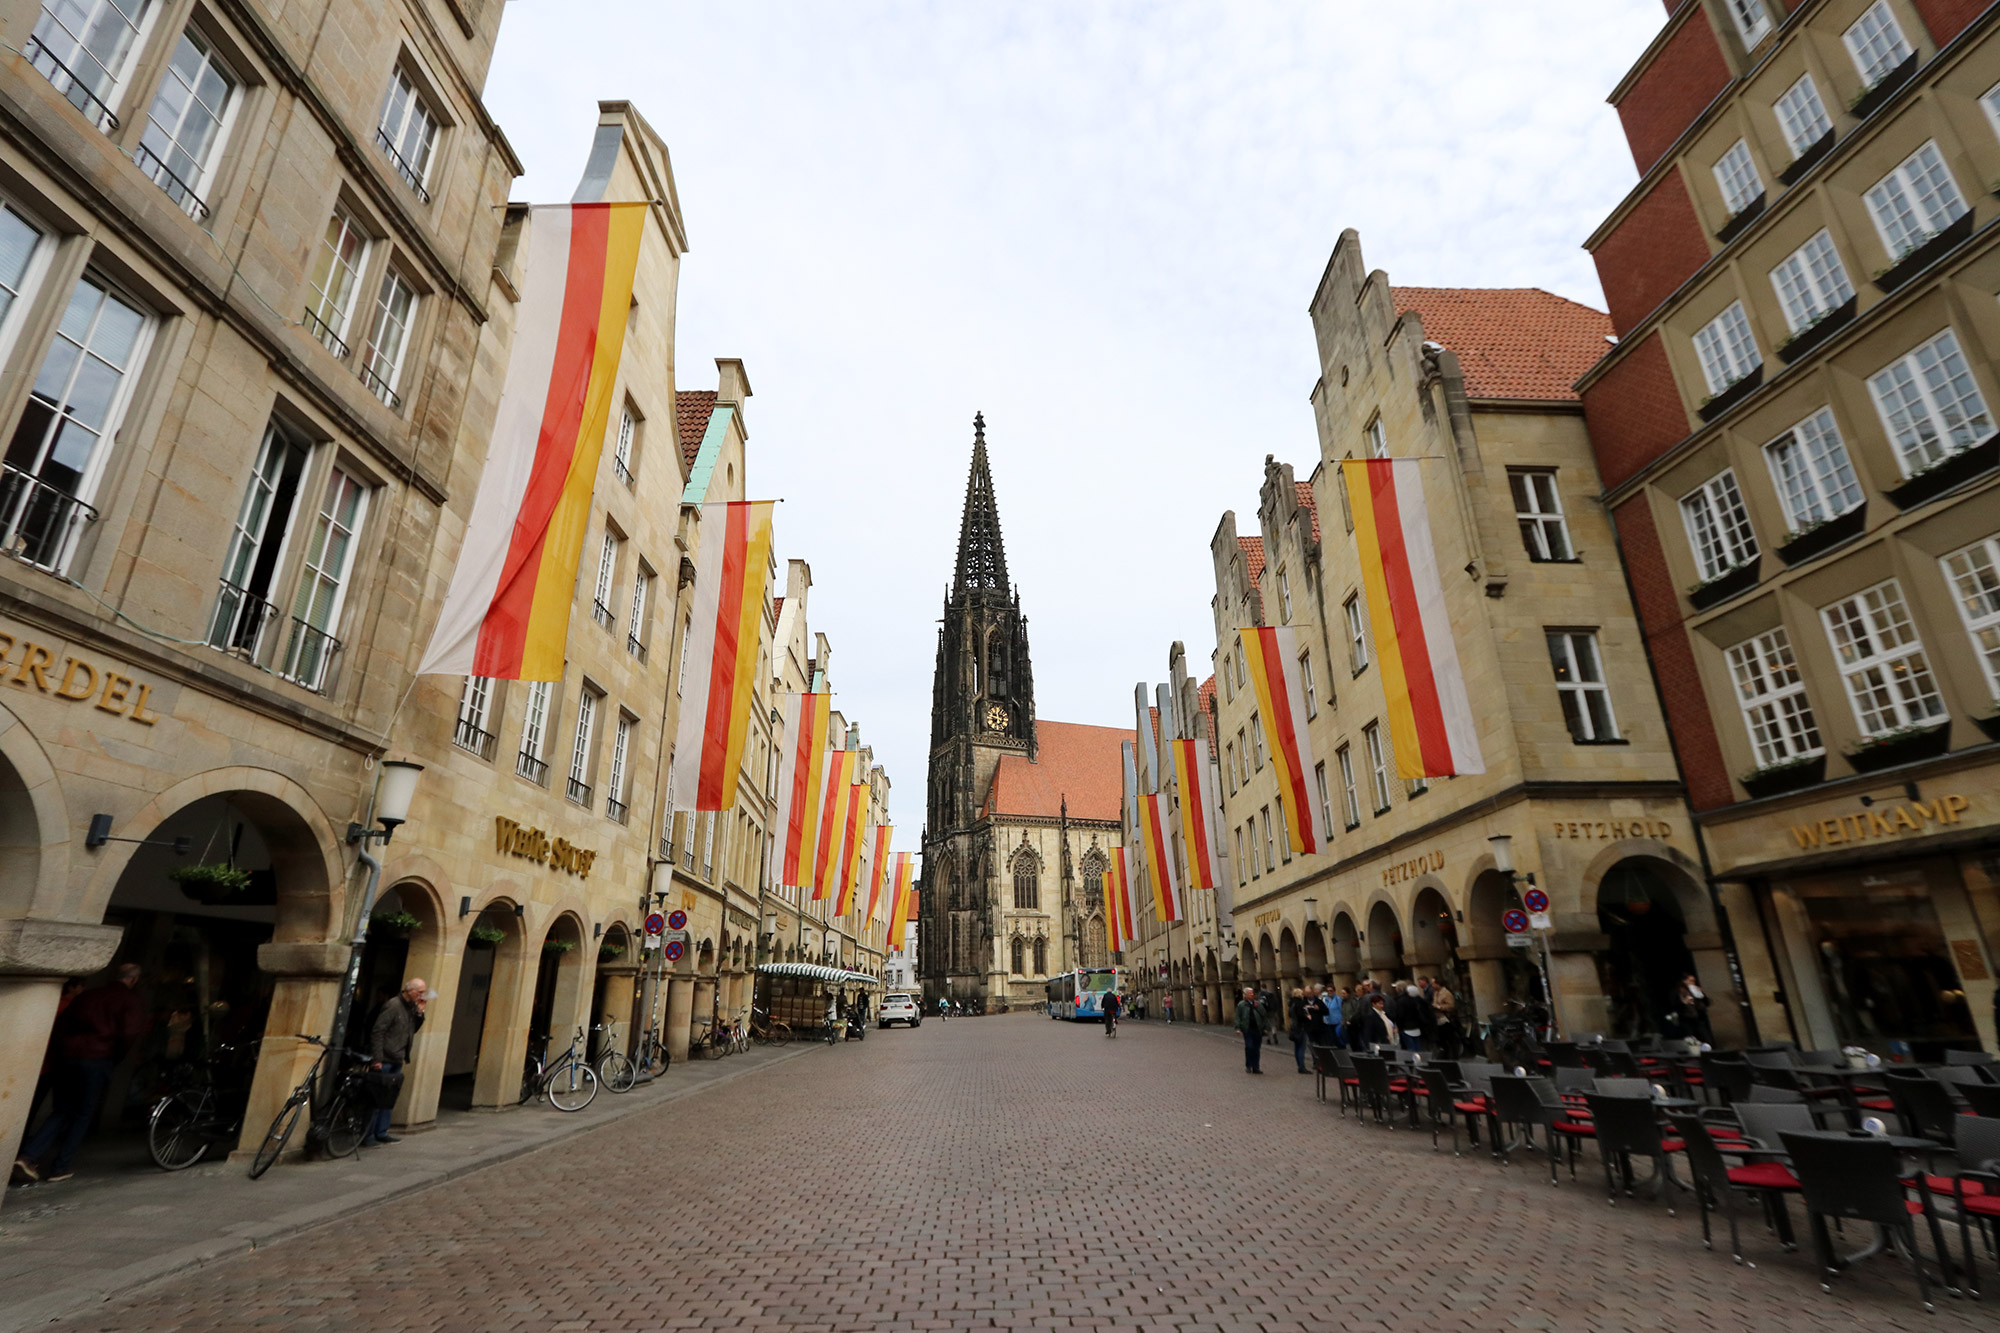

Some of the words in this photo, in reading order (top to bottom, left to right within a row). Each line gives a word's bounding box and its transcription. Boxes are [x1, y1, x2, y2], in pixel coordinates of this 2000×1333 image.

[1553, 821, 1673, 839] PETZHOLD
[1791, 794, 1970, 850] WEITKAMP
[1382, 849, 1445, 887] PETZHOLD
